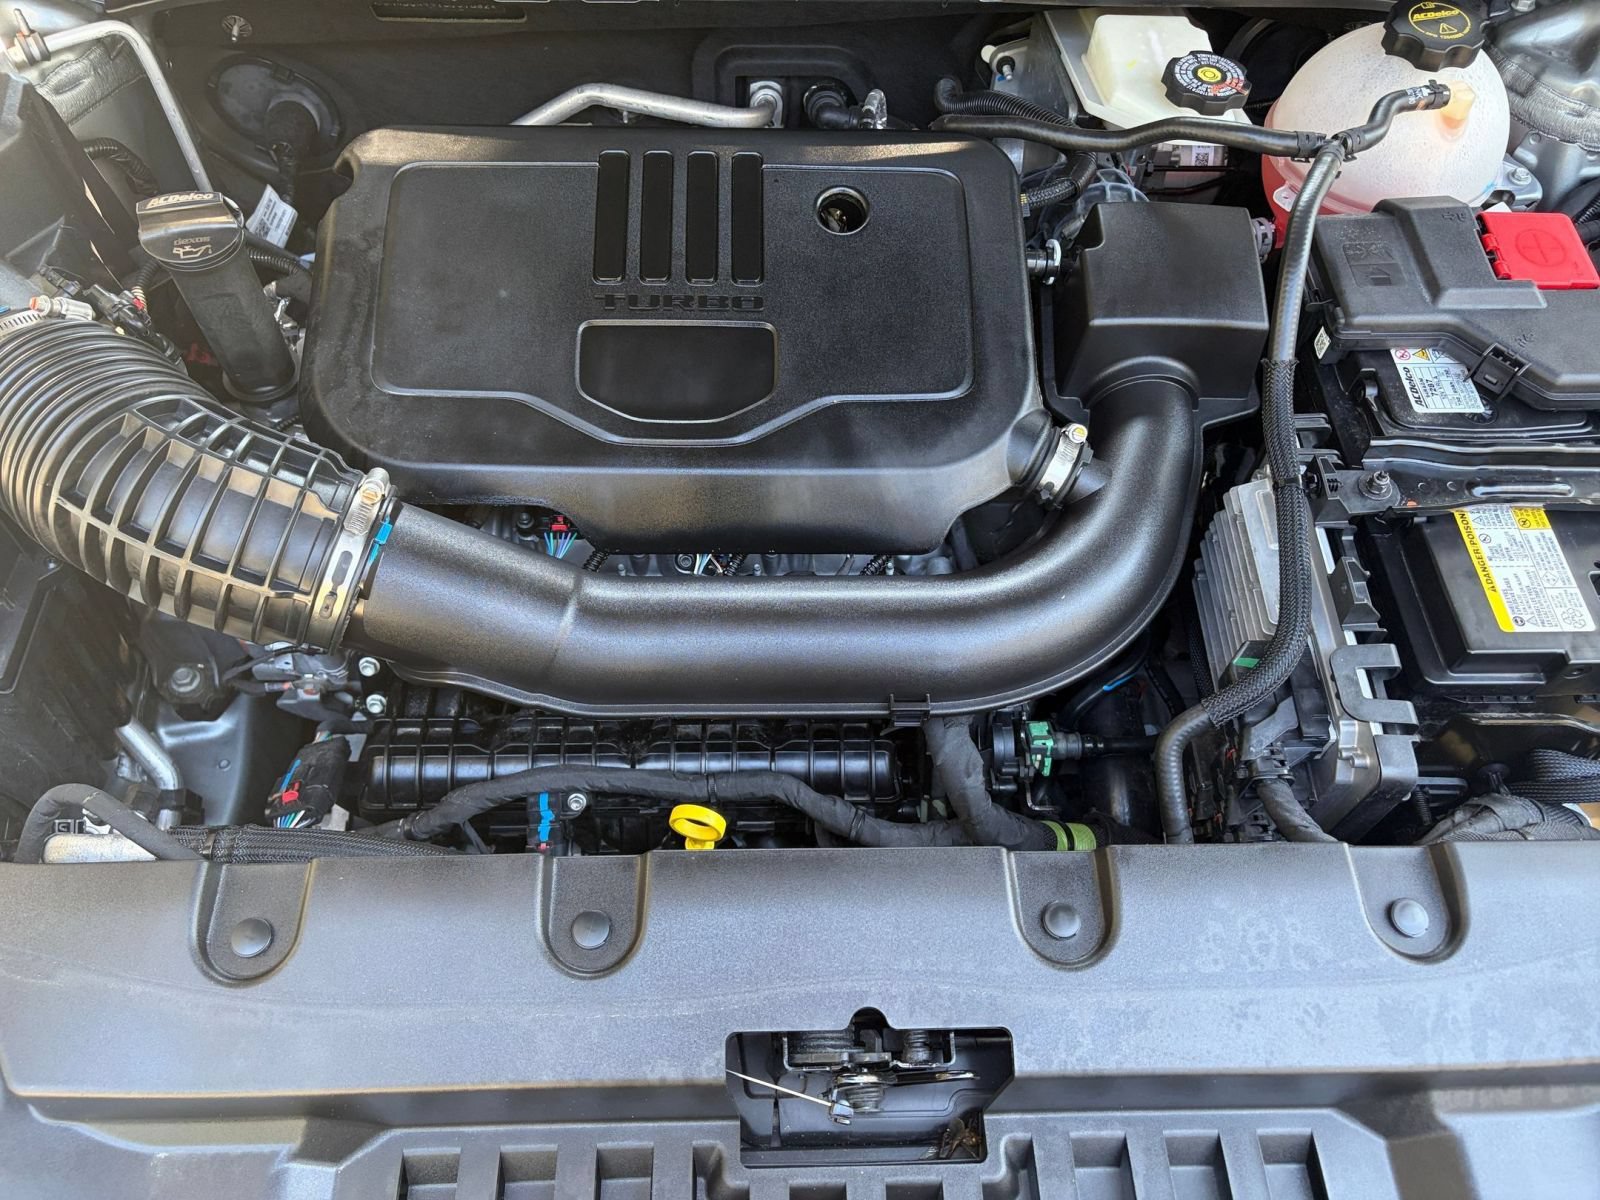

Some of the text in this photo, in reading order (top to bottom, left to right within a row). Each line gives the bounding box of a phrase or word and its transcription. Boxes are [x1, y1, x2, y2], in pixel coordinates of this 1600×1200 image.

[1412, 9, 1460, 20] ACDelco
[145, 192, 214, 210] ACDelco
[173, 236, 211, 246] dexos
[594, 293, 764, 312] TURBO
[1402, 366, 1424, 406] ACDelco
[1424, 378, 1439, 396] 7287
